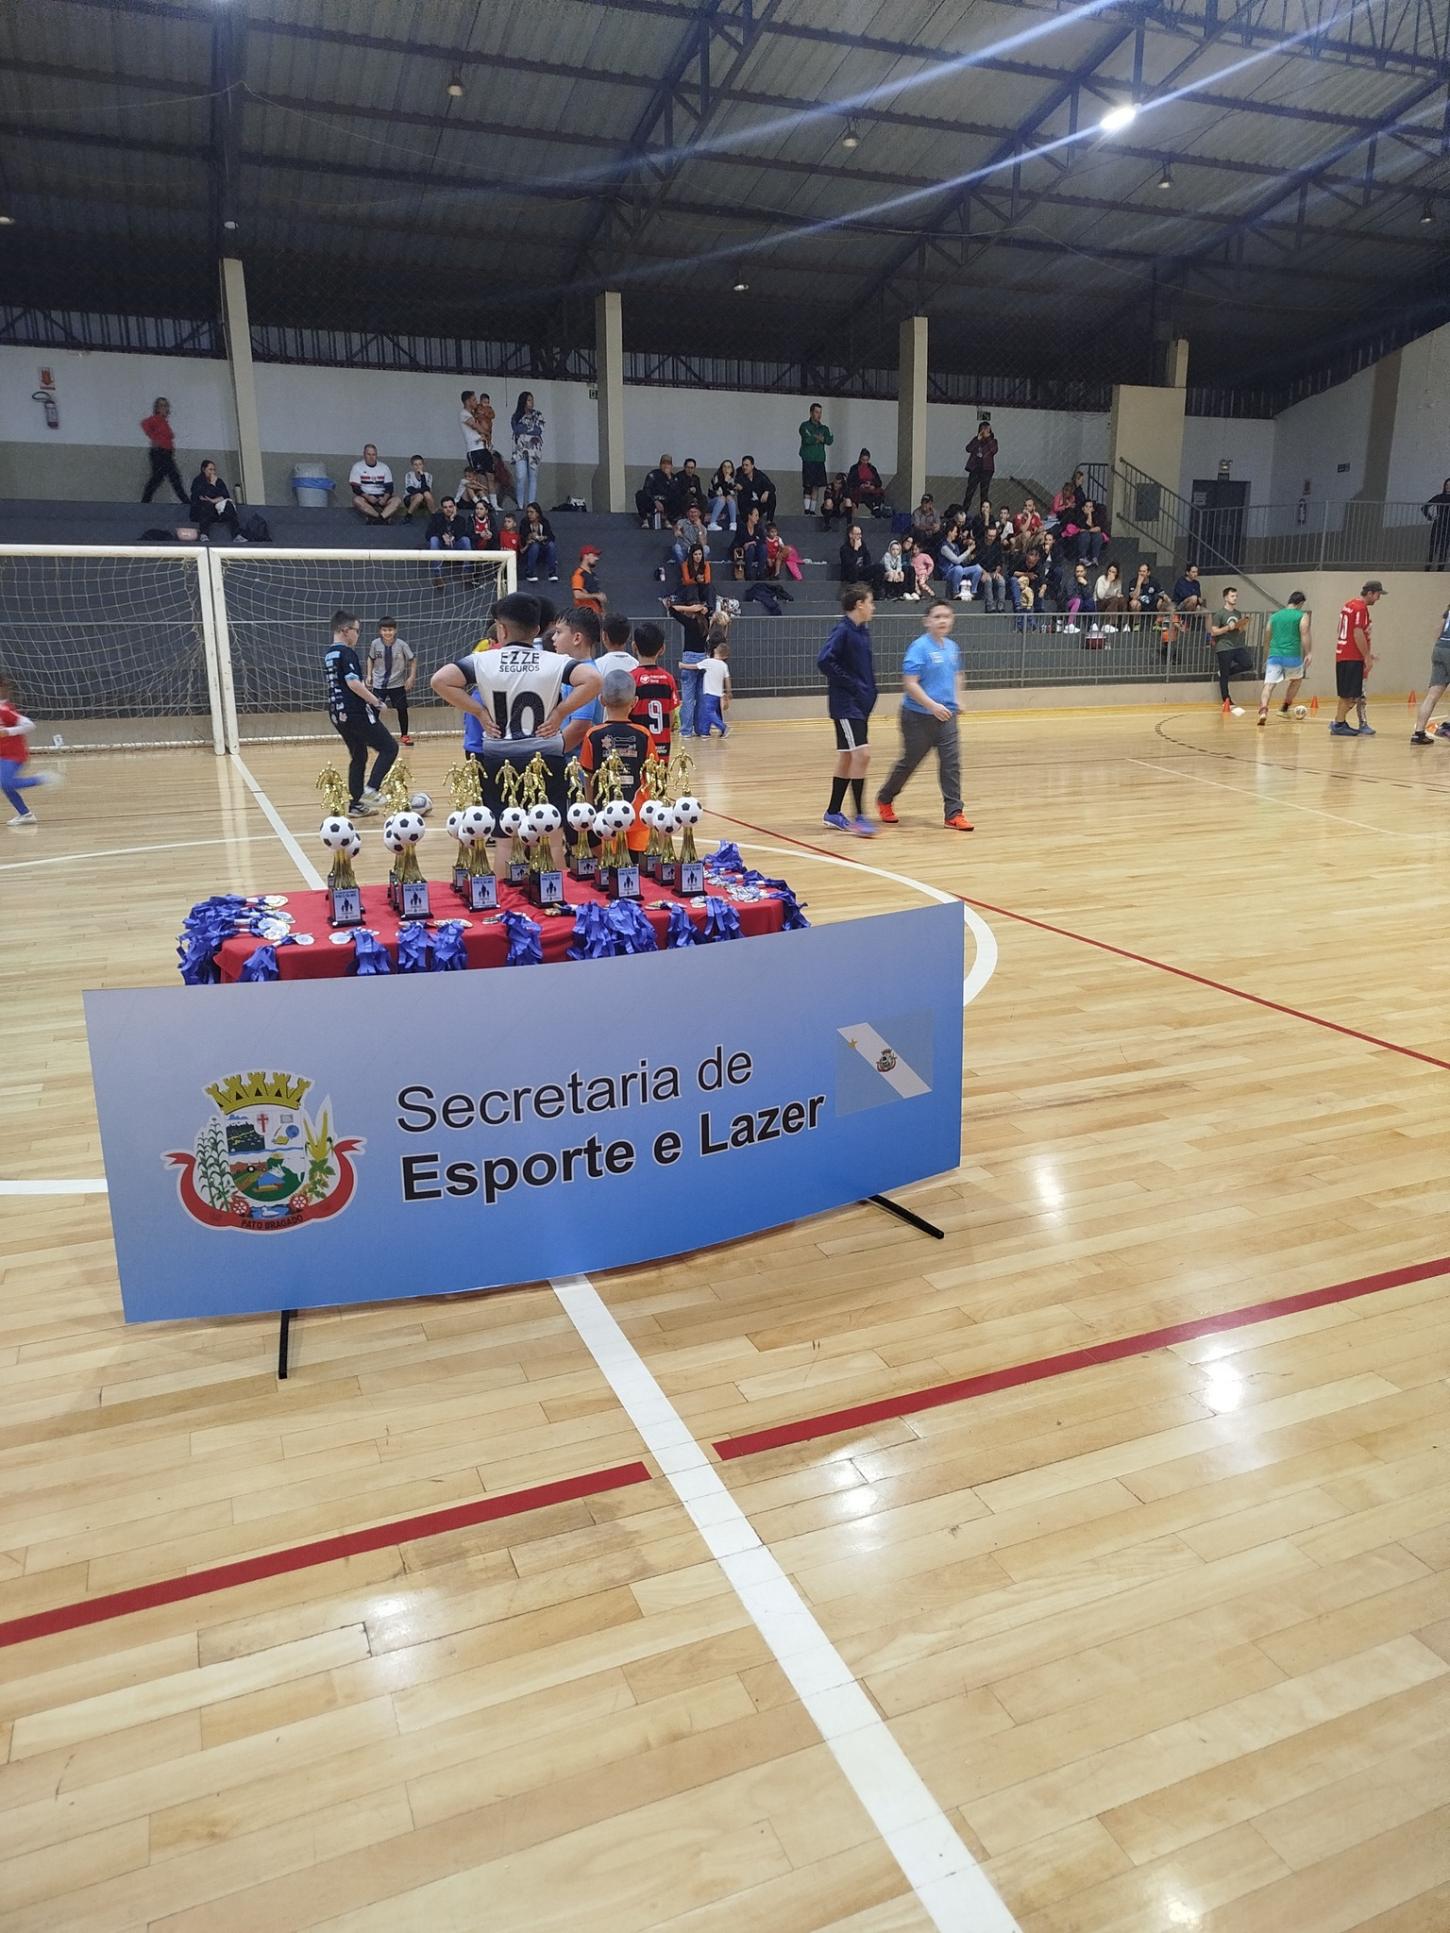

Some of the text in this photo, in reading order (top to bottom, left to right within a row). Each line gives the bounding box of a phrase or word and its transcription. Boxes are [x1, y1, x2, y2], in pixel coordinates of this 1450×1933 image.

[498, 664, 540, 673] SEGUROS
[500, 651, 540, 664] EZZE
[492, 690, 545, 740] 10
[647, 699, 664, 735] 9
[398, 1046, 752, 1132] Secretaria de
[402, 1095, 825, 1204] Esporte e Lazer
[241, 1214, 304, 1230] PATO BRAGADO
